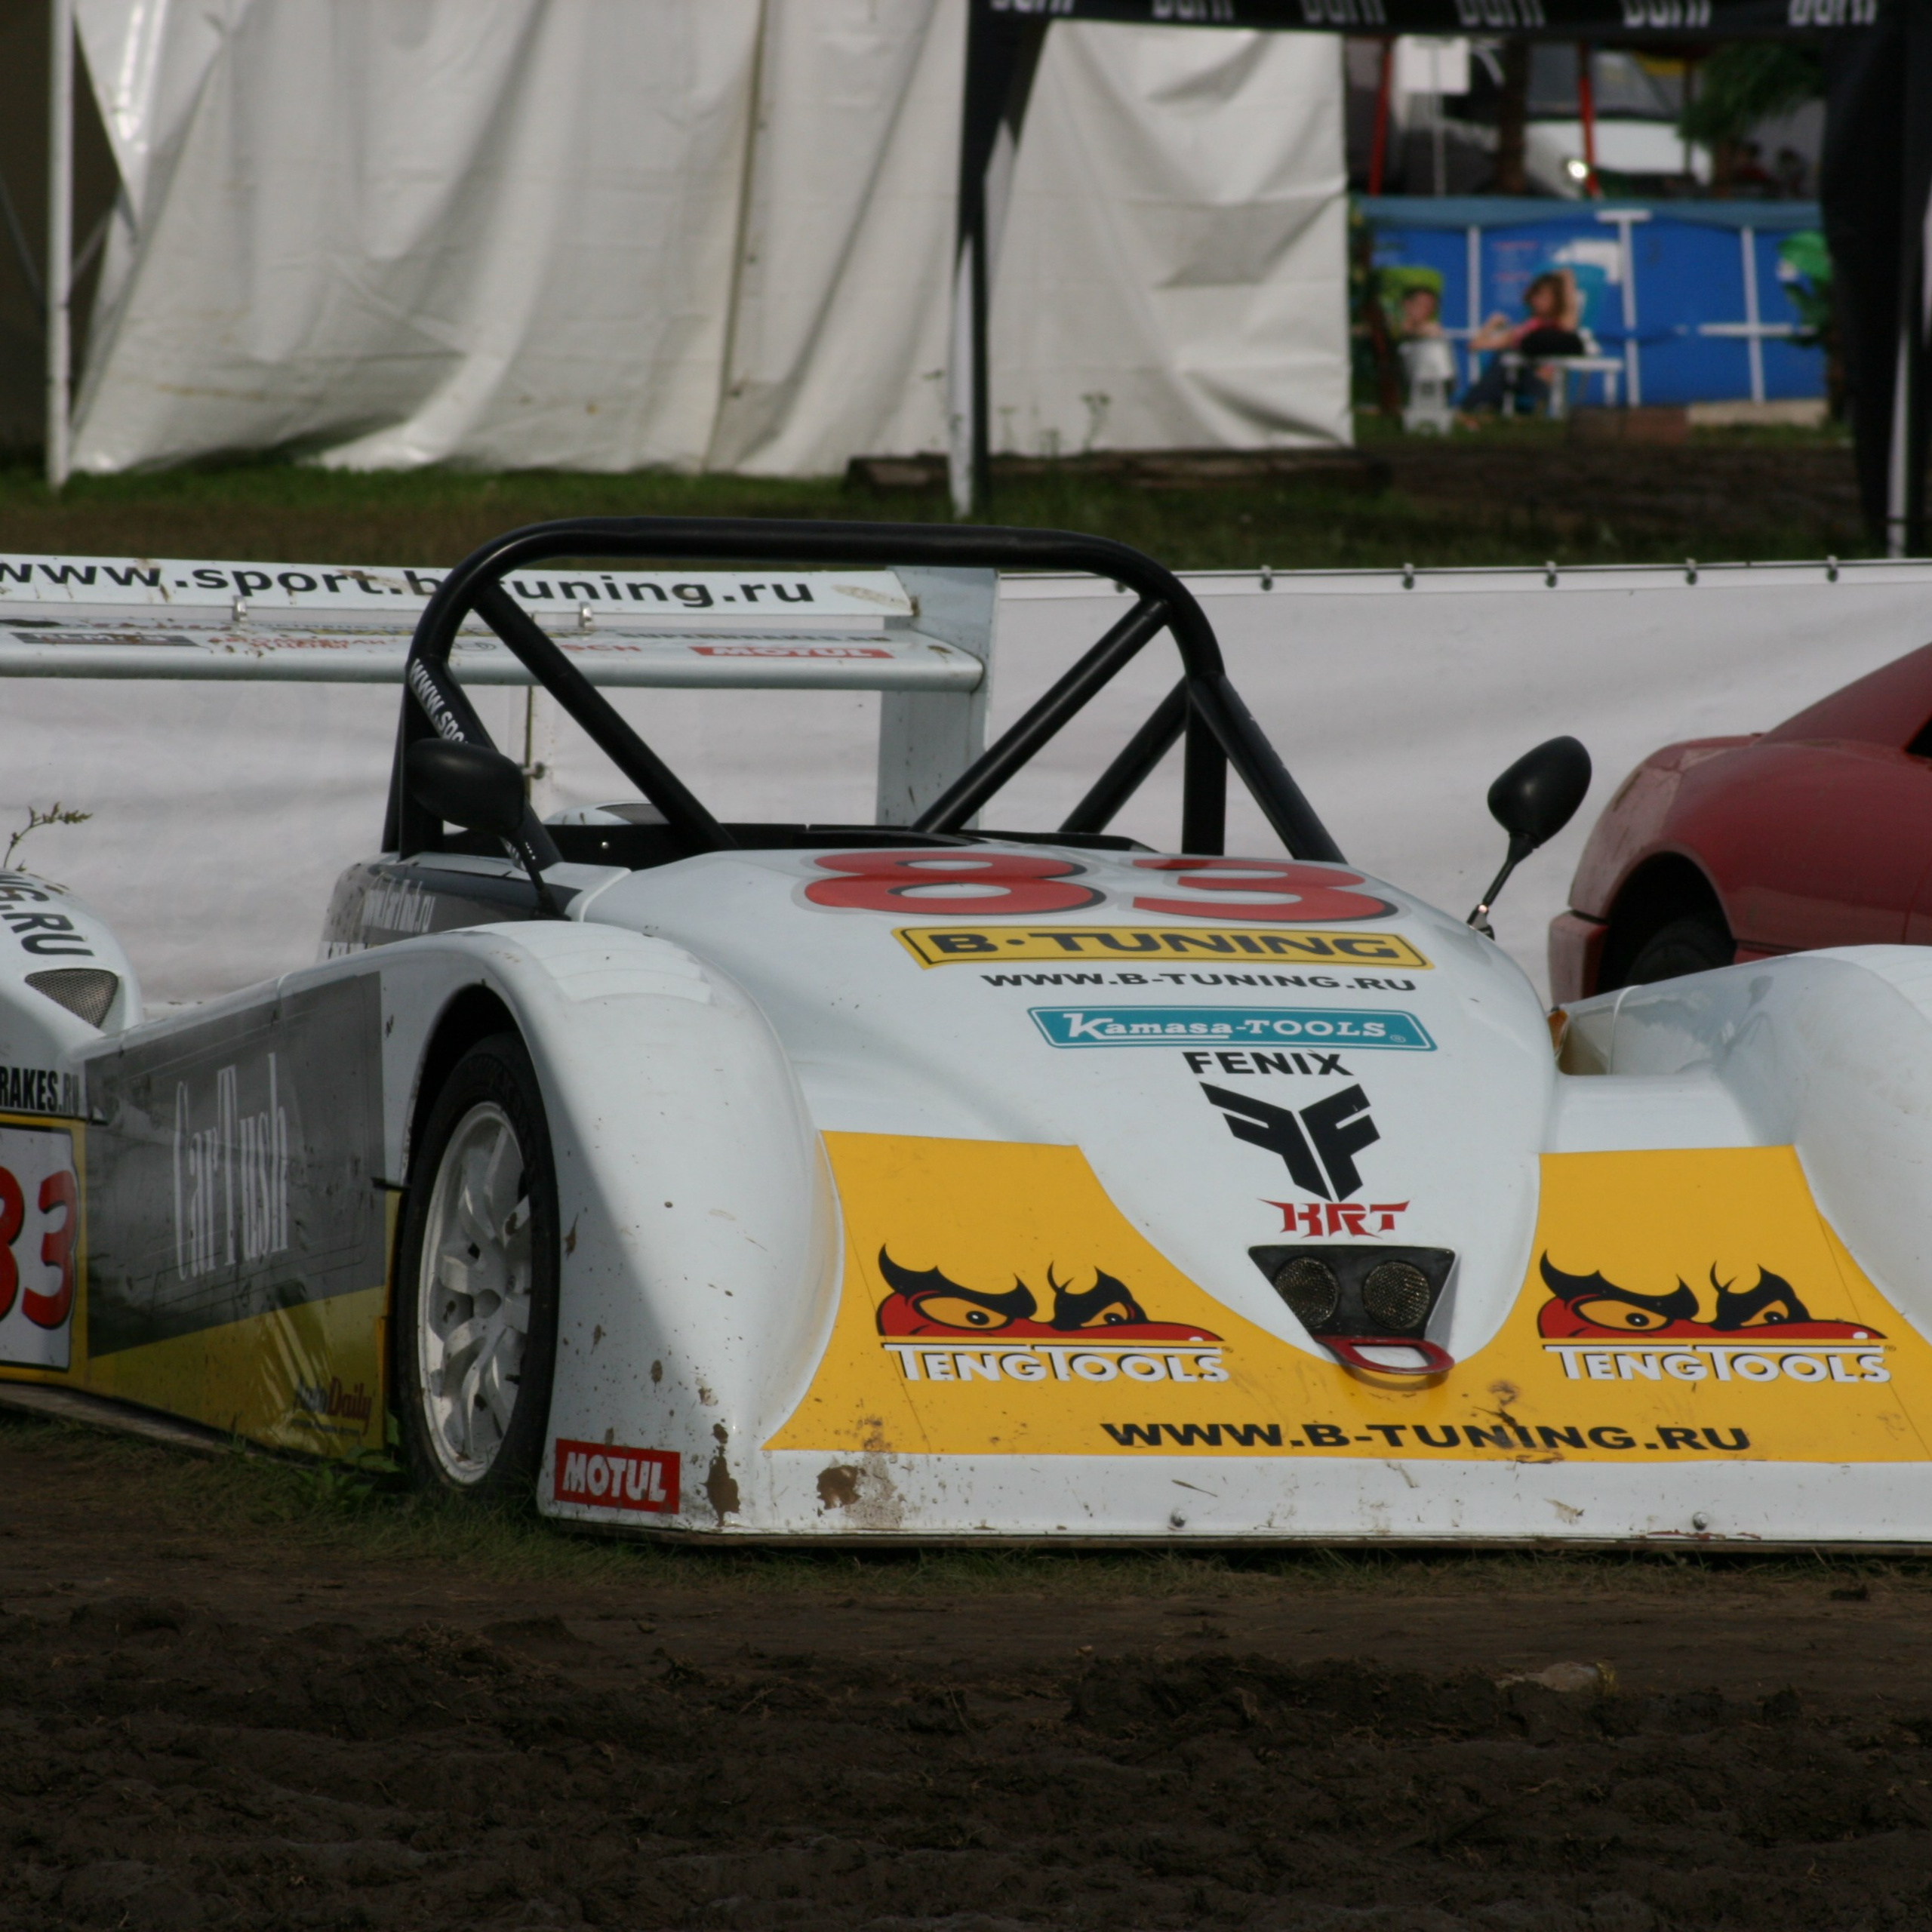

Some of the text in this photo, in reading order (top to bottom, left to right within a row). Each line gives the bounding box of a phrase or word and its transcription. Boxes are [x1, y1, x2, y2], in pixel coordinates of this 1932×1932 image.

[711, 648, 875, 657] MOTUL
[804, 851, 1398, 921] 83
[980, 973, 1417, 992] WWW.B-TUNING.RU
[1063, 1013, 1386, 1039] Kamasa-TOOLS
[1182, 1051, 1355, 1076] FENIX
[1100, 1423, 1751, 1451] WWW.B-TUNING.RU
[562, 1451, 666, 1502] MOTUL
